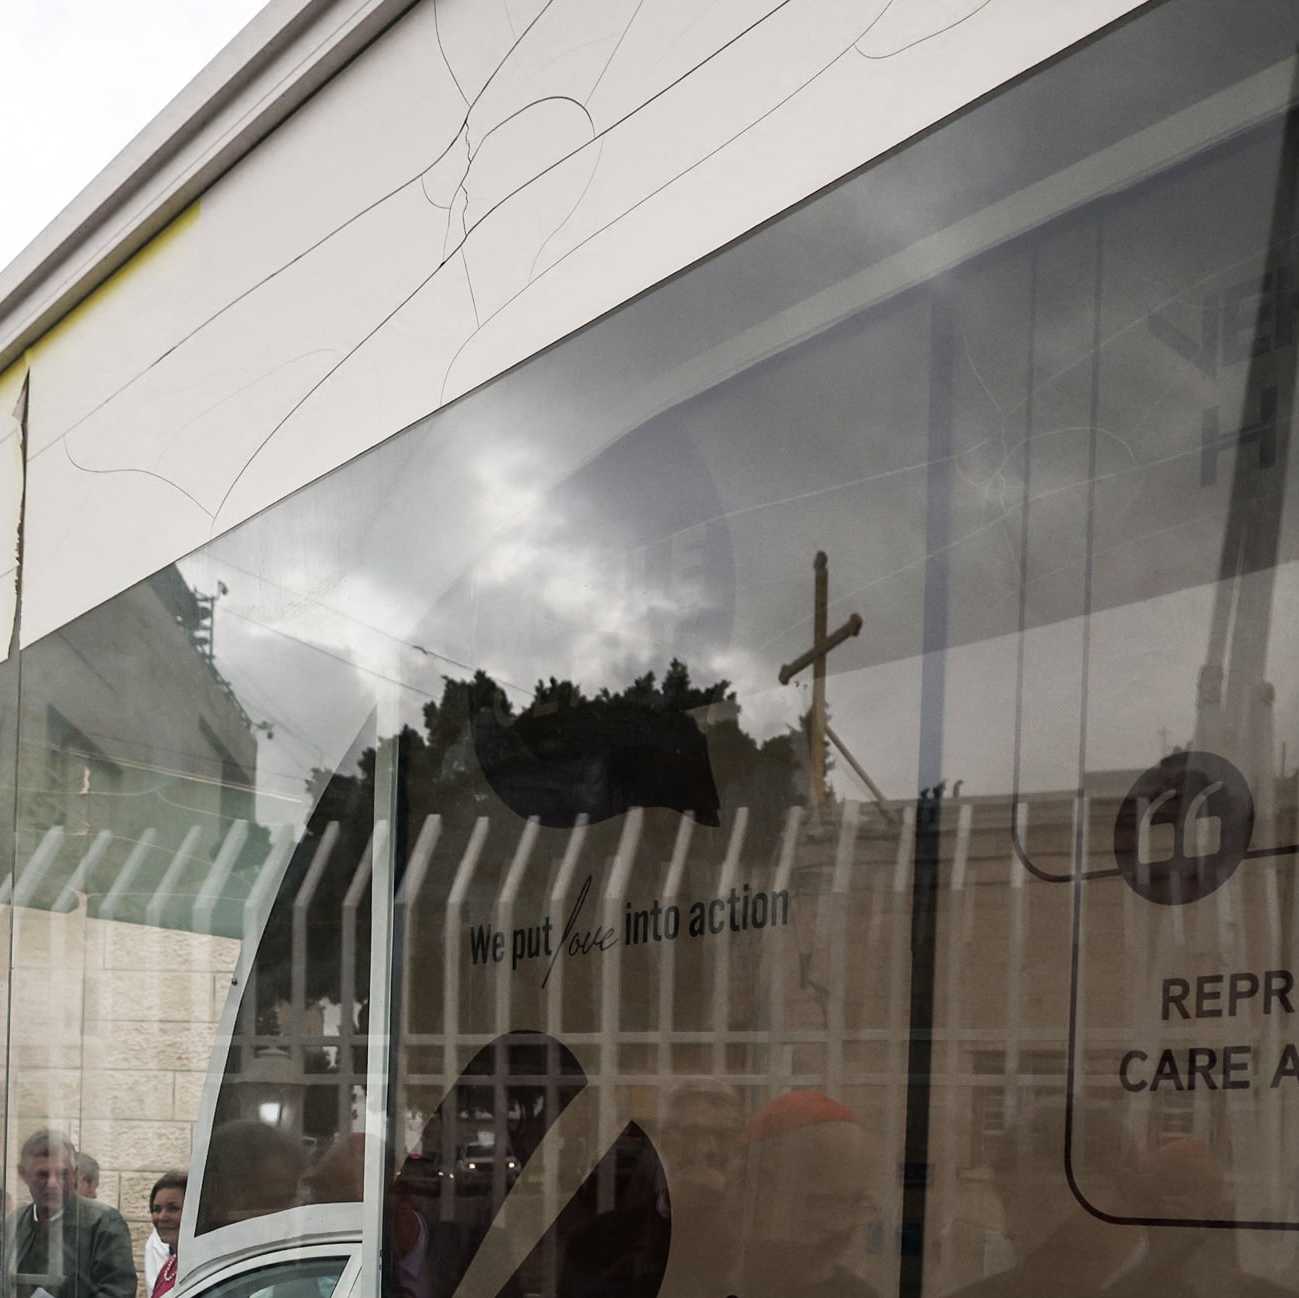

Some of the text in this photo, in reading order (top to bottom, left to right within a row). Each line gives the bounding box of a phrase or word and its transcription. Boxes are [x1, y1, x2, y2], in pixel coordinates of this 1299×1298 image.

[470, 874, 789, 989] We put love into action
[1118, 1046, 1251, 1093] CARE
